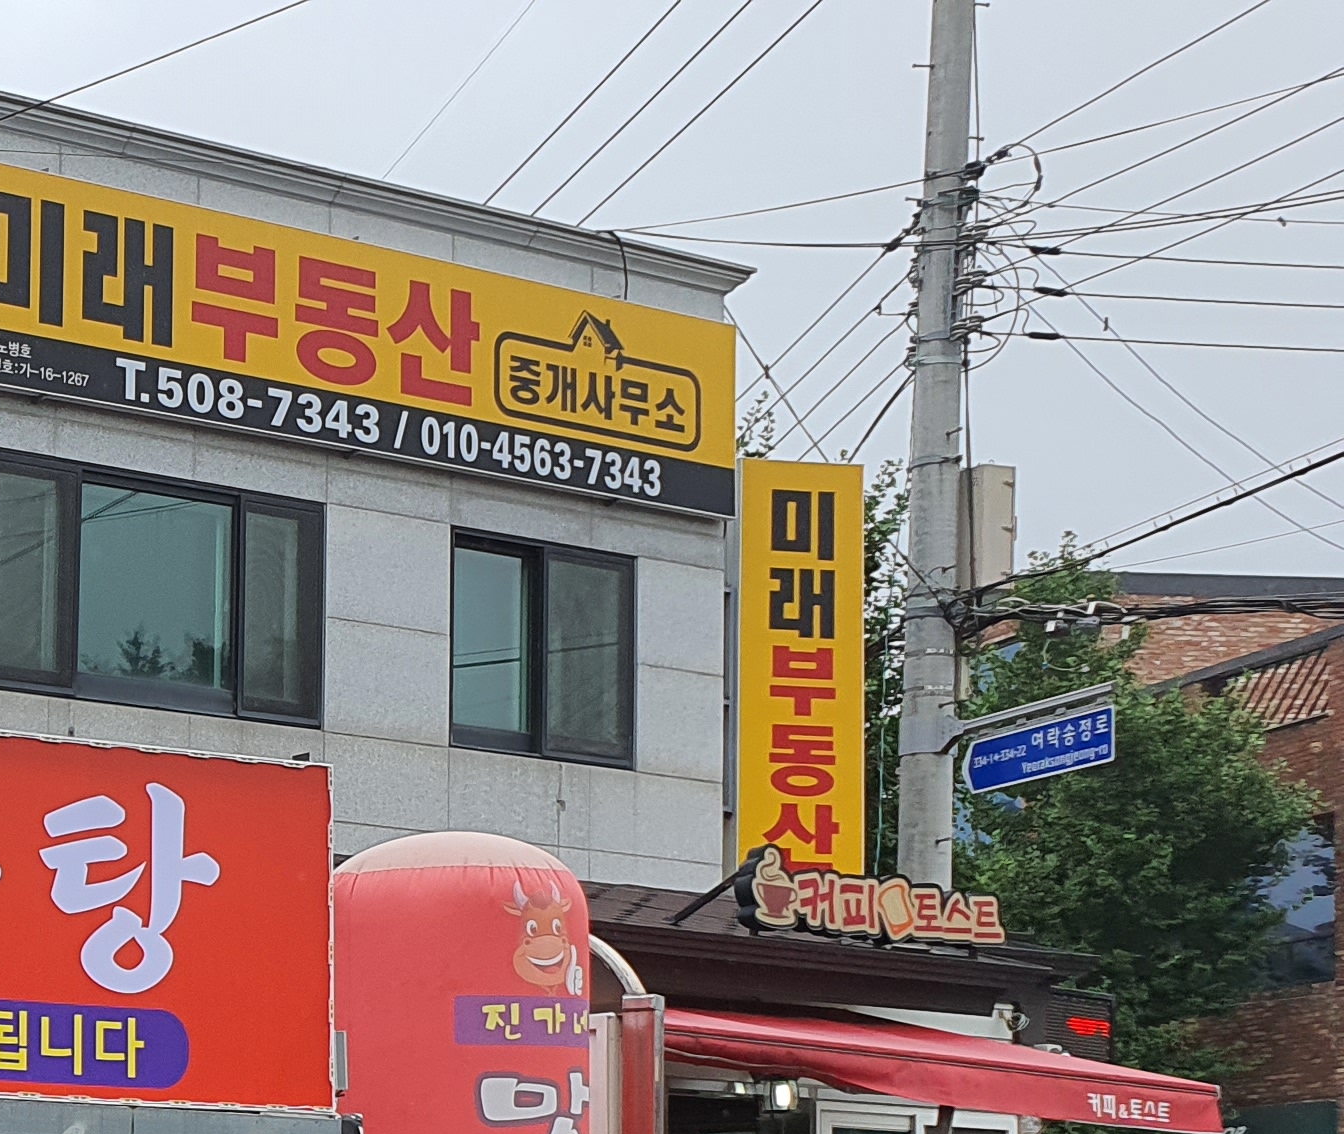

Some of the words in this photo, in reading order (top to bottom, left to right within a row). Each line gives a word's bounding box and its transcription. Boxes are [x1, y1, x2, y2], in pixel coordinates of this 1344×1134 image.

[116, 356, 382, 444] T.508-7343
[421, 417, 663, 498] 010-4563-7343
[508, 354, 687, 436] 중개사무소
[1031, 714, 1110, 749] 여락송정로
[798, 878, 876, 929] 커피
[913, 893, 1002, 939] 토스트
